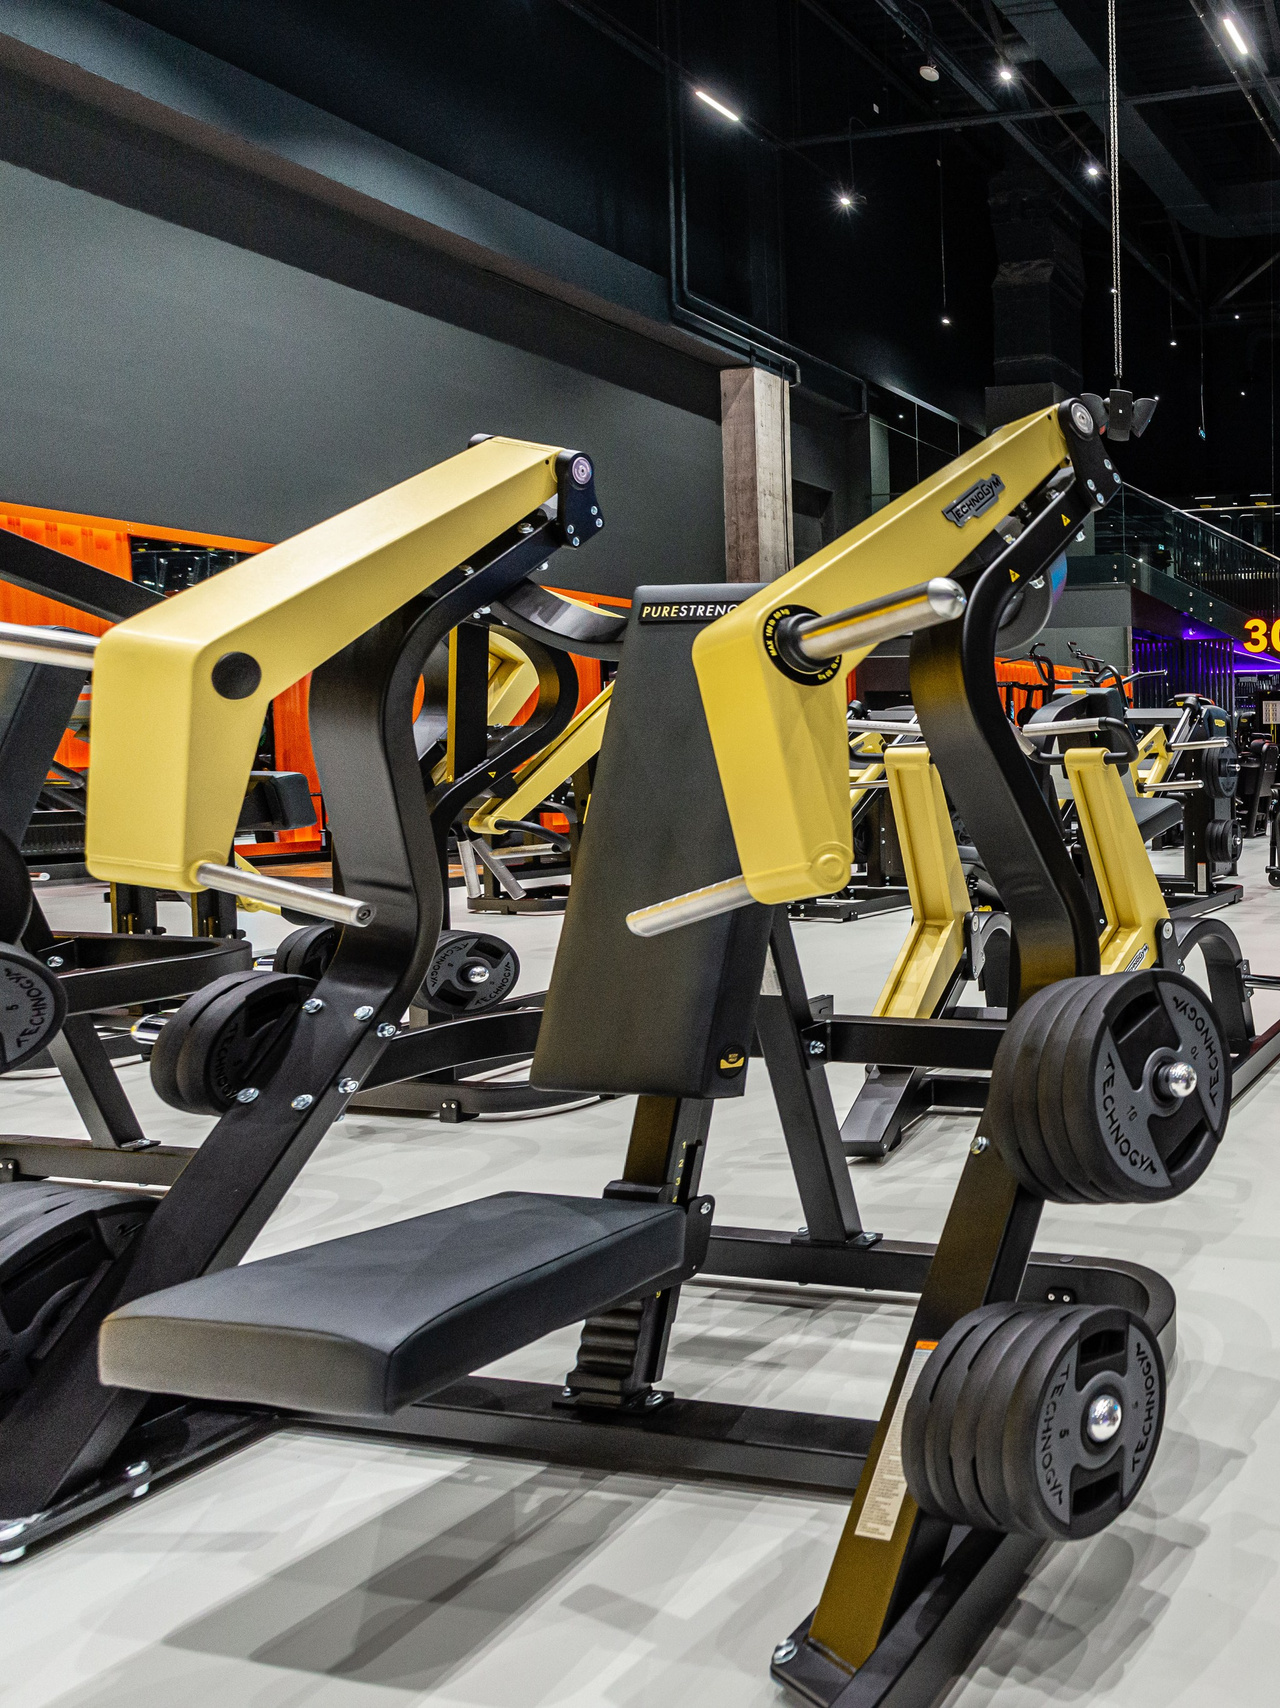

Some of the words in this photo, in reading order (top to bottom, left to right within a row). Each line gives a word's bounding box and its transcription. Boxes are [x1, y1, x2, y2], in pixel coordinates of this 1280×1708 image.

[945, 478, 1002, 523] TECHNOGYM
[642, 604, 739, 618] PURESTREN
[431, 942, 469, 988] TECHNOGYM
[474, 961, 510, 1006] TECHNOGYM
[4, 967, 47, 1048] TECHNOGYM
[1172, 995, 1219, 1107] TECHNOGYM
[1102, 1052, 1158, 1175] TECHNOGYM
[1126, 1105, 1138, 1123] 10
[678, 1158, 684, 1168] 2
[682, 1141, 687, 1149] 1
[675, 1177, 681, 1186] 3
[1131, 1341, 1155, 1473] TECHNOGYM
[1040, 1362, 1070, 1506] TECHNOGYM
[1058, 1428, 1070, 1439] 5
